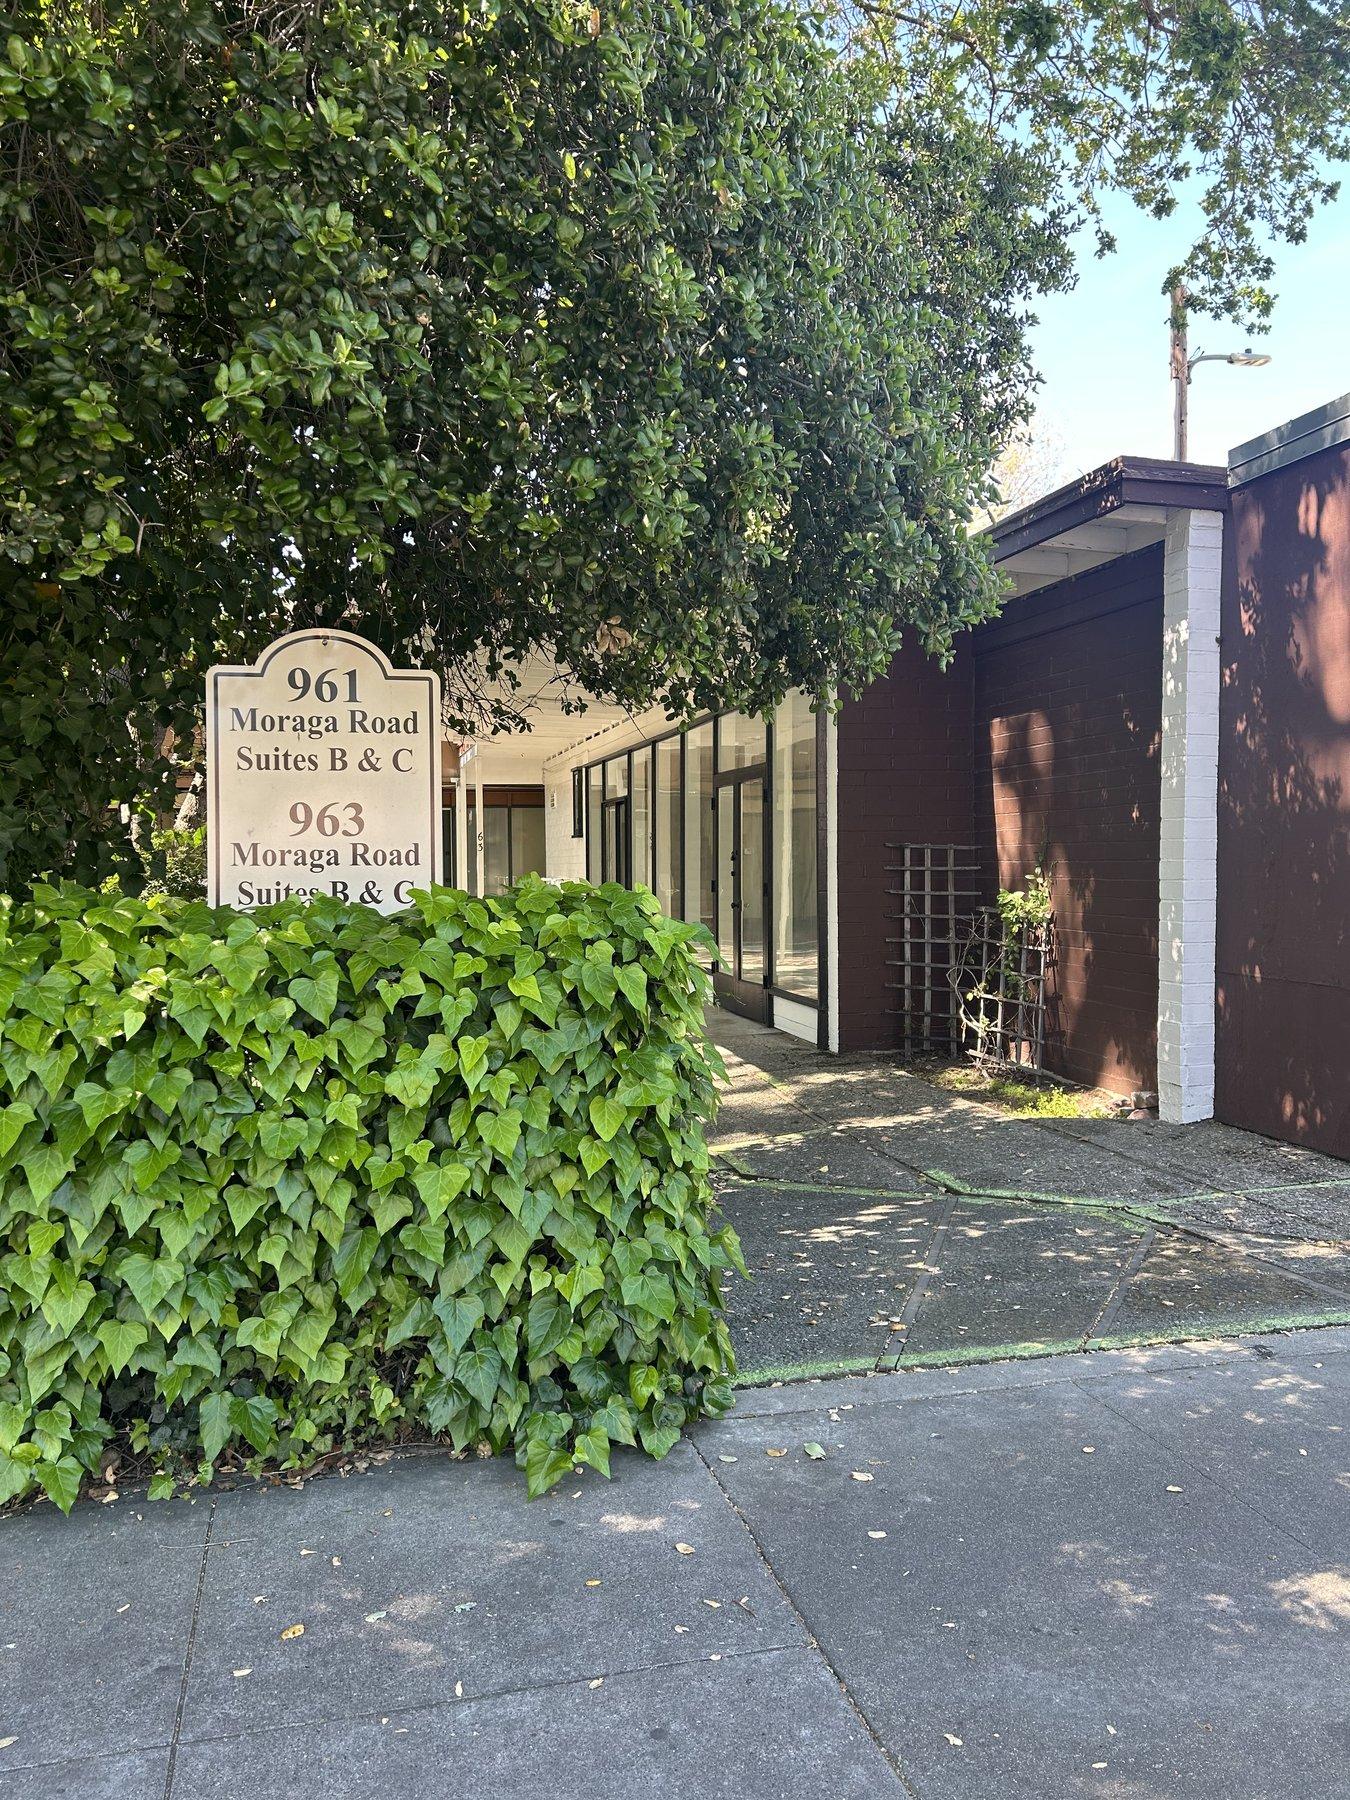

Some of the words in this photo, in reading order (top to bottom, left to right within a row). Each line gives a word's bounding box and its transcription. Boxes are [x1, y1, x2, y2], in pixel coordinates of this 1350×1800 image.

[287, 667, 362, 703] 961
[230, 707, 339, 740] Moraga
[348, 709, 419, 735] Road
[236, 746, 319, 772] Suites
[328, 747, 348, 772] B
[358, 747, 383, 773] &
[392, 748, 413, 773] C
[289, 802, 365, 837] 963
[230, 842, 340, 874] Moraga
[350, 842, 421, 867] Road
[329, 880, 349, 904] B
[359, 880, 383, 904] &
[393, 880, 415, 904] C
